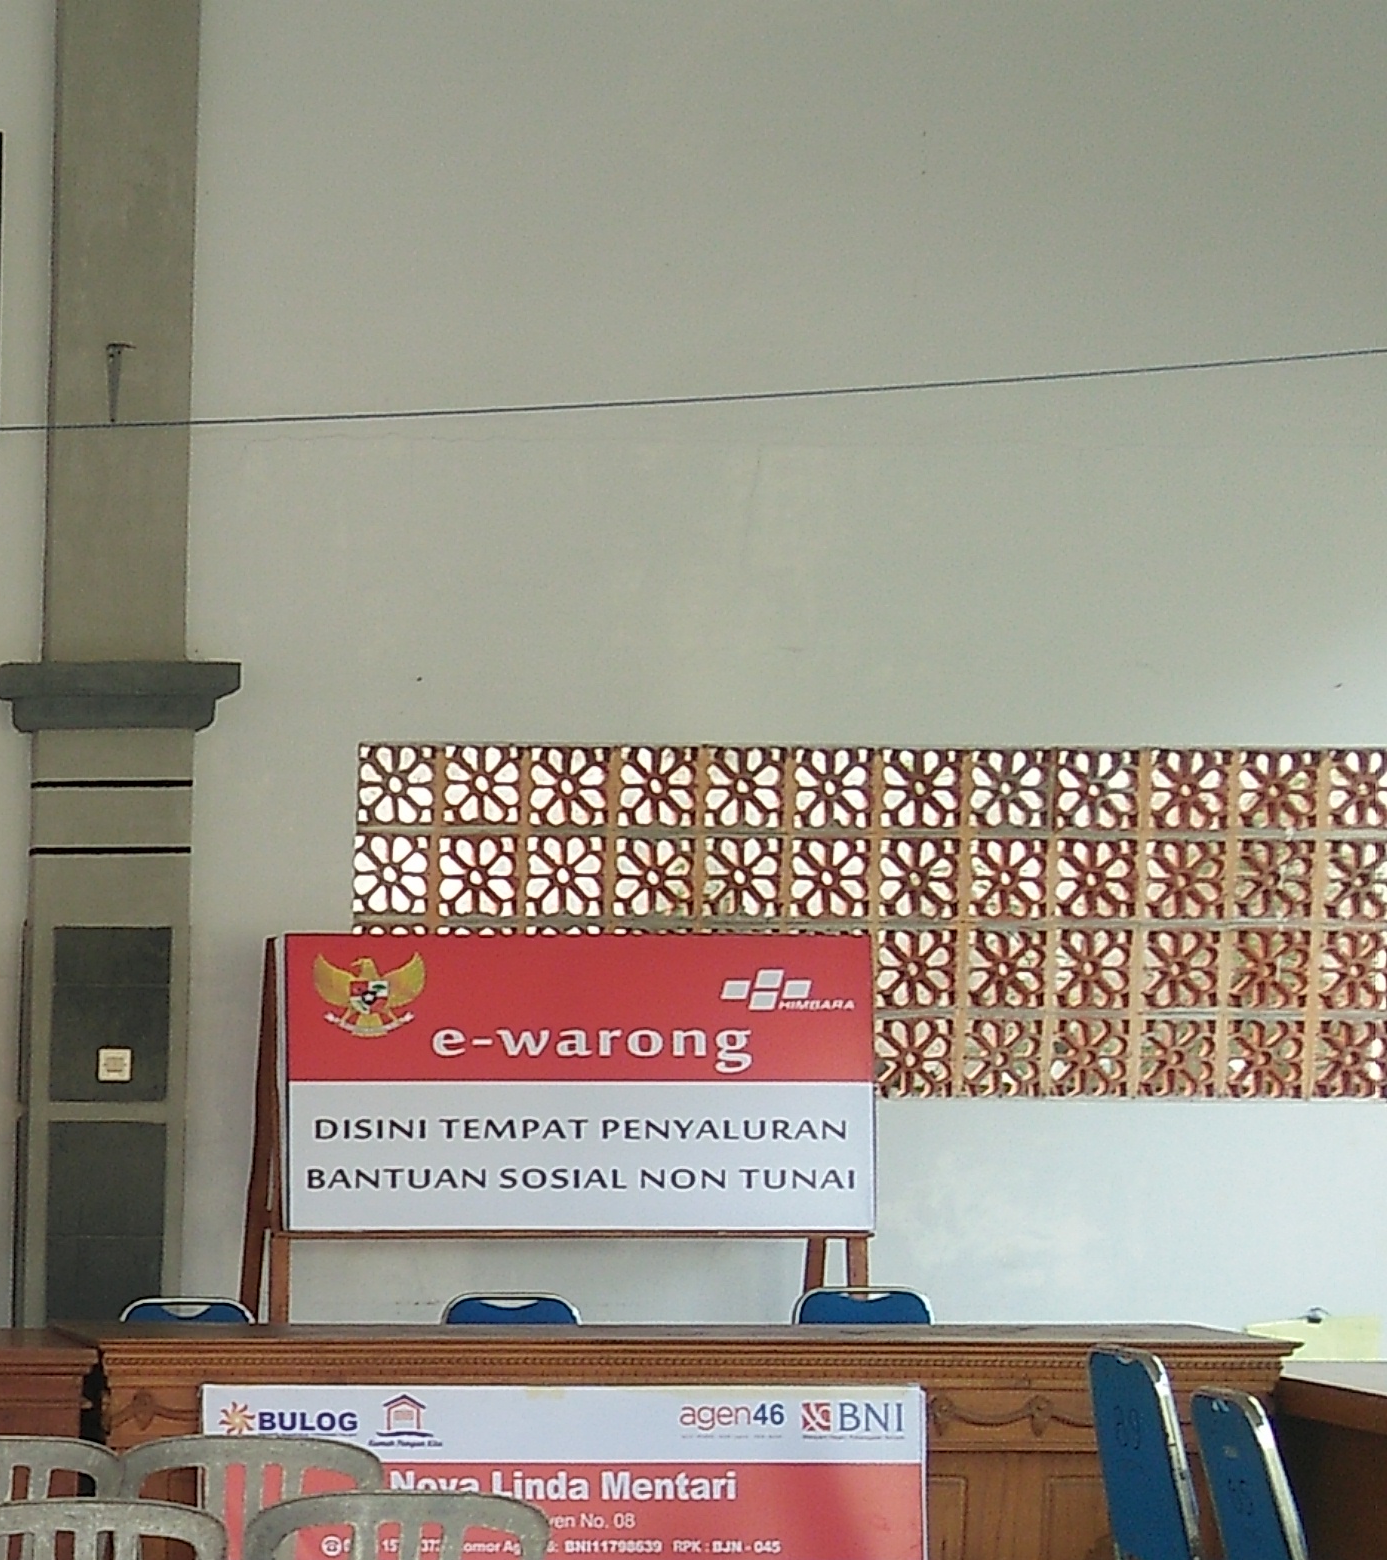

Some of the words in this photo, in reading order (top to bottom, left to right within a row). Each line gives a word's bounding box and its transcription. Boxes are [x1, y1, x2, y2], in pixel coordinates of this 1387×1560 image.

[431, 1023, 754, 1073] e-warong
[314, 1118, 427, 1140] DISINI
[438, 1118, 589, 1141] TEMPAT
[600, 1118, 848, 1142] PENYALURAN
[306, 1167, 488, 1190] BANTUAN
[498, 1167, 628, 1191] SOSIAL
[639, 1167, 726, 1190] NON
[739, 1167, 856, 1190] TUNAI
[258, 1411, 358, 1431] BULOG
[679, 1403, 785, 1430] agen46
[839, 1402, 904, 1431] BNI
[491, 1471, 590, 1500] Linda
[600, 1471, 737, 1500] Mentari
[580, 1513, 609, 1529] No.
[673, 1541, 702, 1554] RPK
